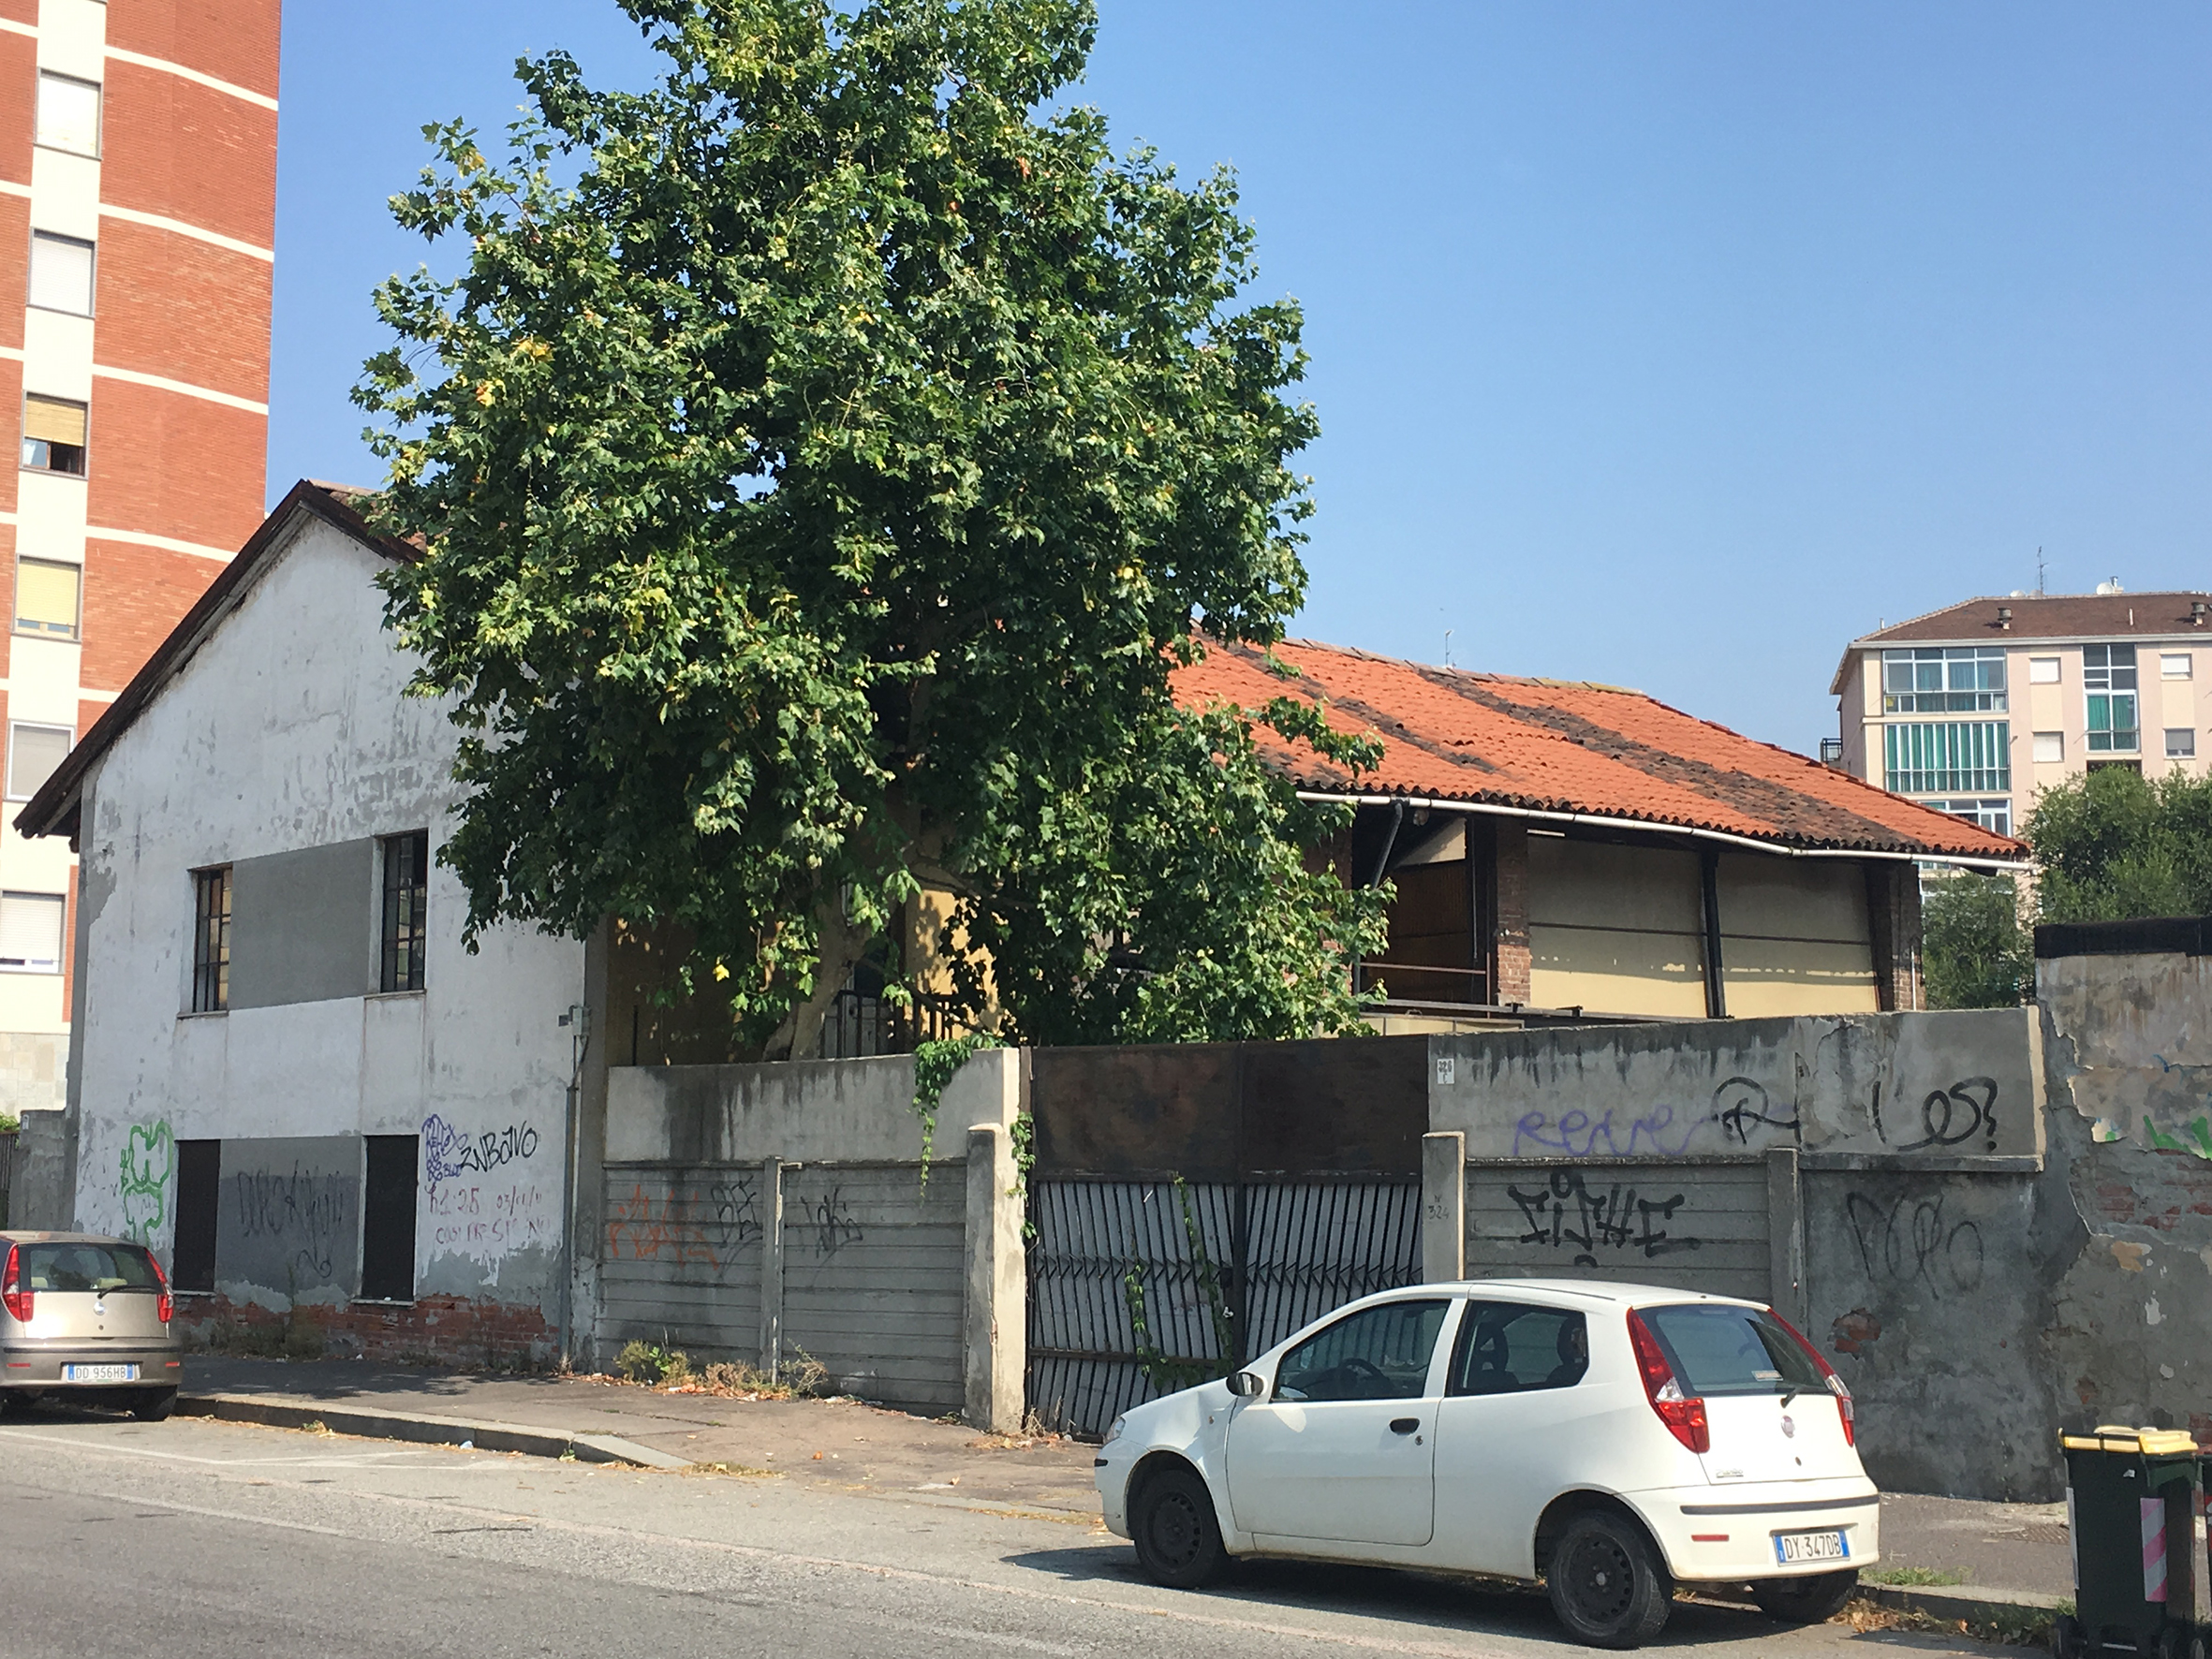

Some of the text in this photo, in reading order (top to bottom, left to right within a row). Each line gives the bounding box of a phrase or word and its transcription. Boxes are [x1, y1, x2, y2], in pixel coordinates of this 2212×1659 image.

[1428, 1205, 1450, 1220] 324
[76, 1367, 126, 1379] DD 956HB
[1784, 1534, 1842, 1560] DY 347DB
